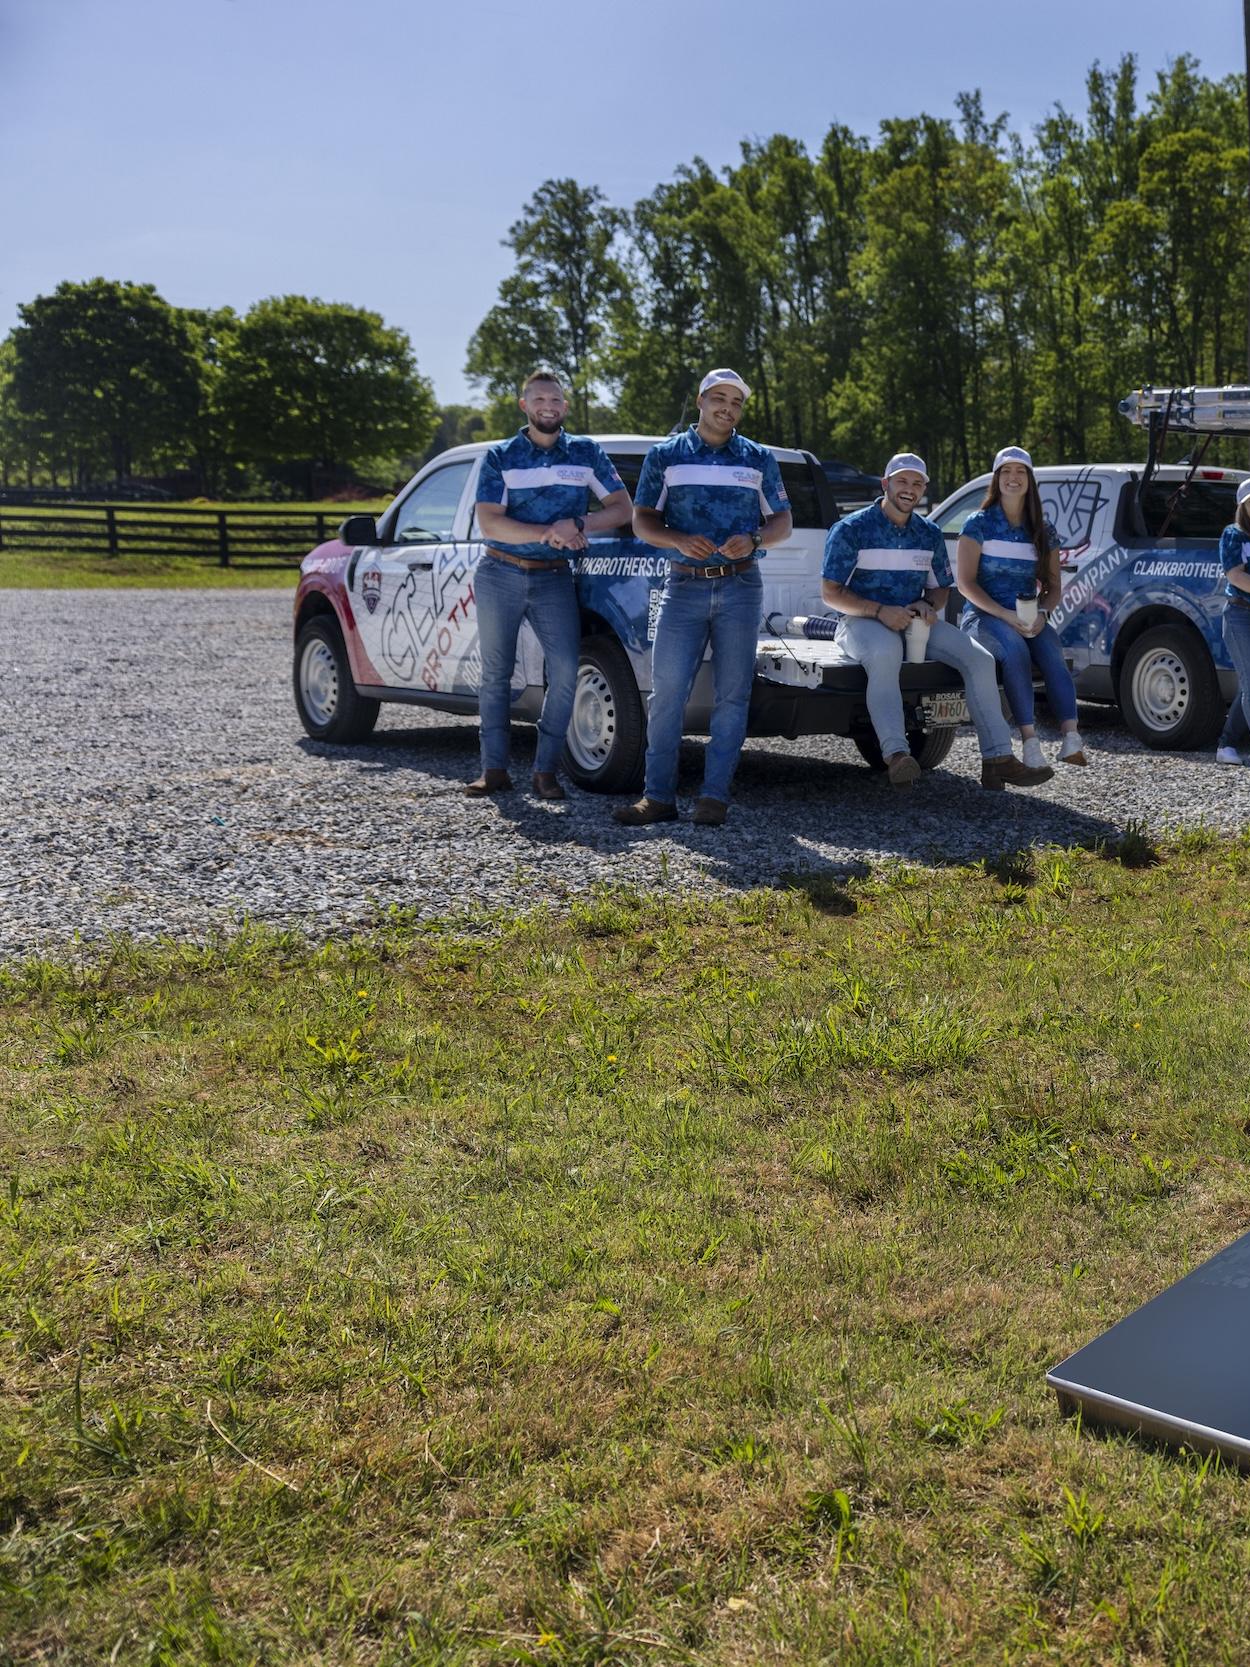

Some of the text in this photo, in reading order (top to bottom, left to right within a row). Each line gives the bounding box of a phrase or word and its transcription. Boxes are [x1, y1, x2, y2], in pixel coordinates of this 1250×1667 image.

[1062, 546, 1129, 613] COMPANY
[1133, 560, 1226, 578] CLARKBROTHER
[421, 583, 477, 693] BROTH
[935, 692, 961, 701] BOSAK
